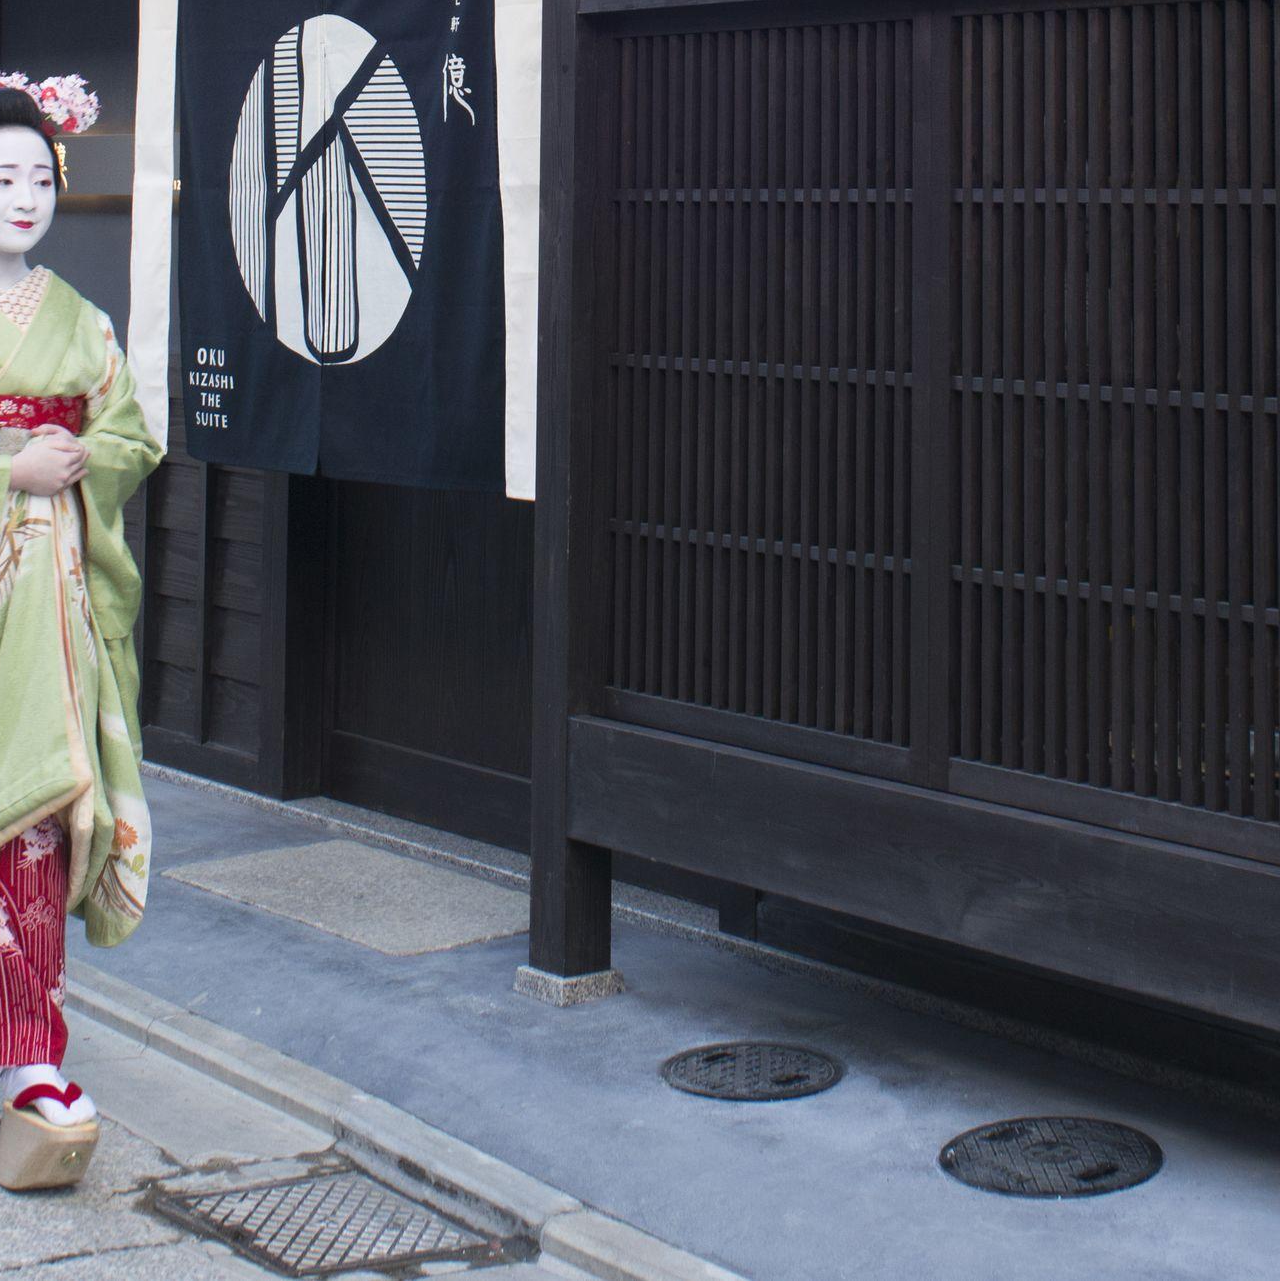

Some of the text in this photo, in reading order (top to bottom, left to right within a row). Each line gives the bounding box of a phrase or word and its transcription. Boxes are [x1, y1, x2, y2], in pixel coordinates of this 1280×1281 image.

[197, 347, 225, 368] OKU
[189, 371, 234, 390] KIZASHI
[200, 392, 221, 408] THE
[195, 411, 228, 429] SUITE
